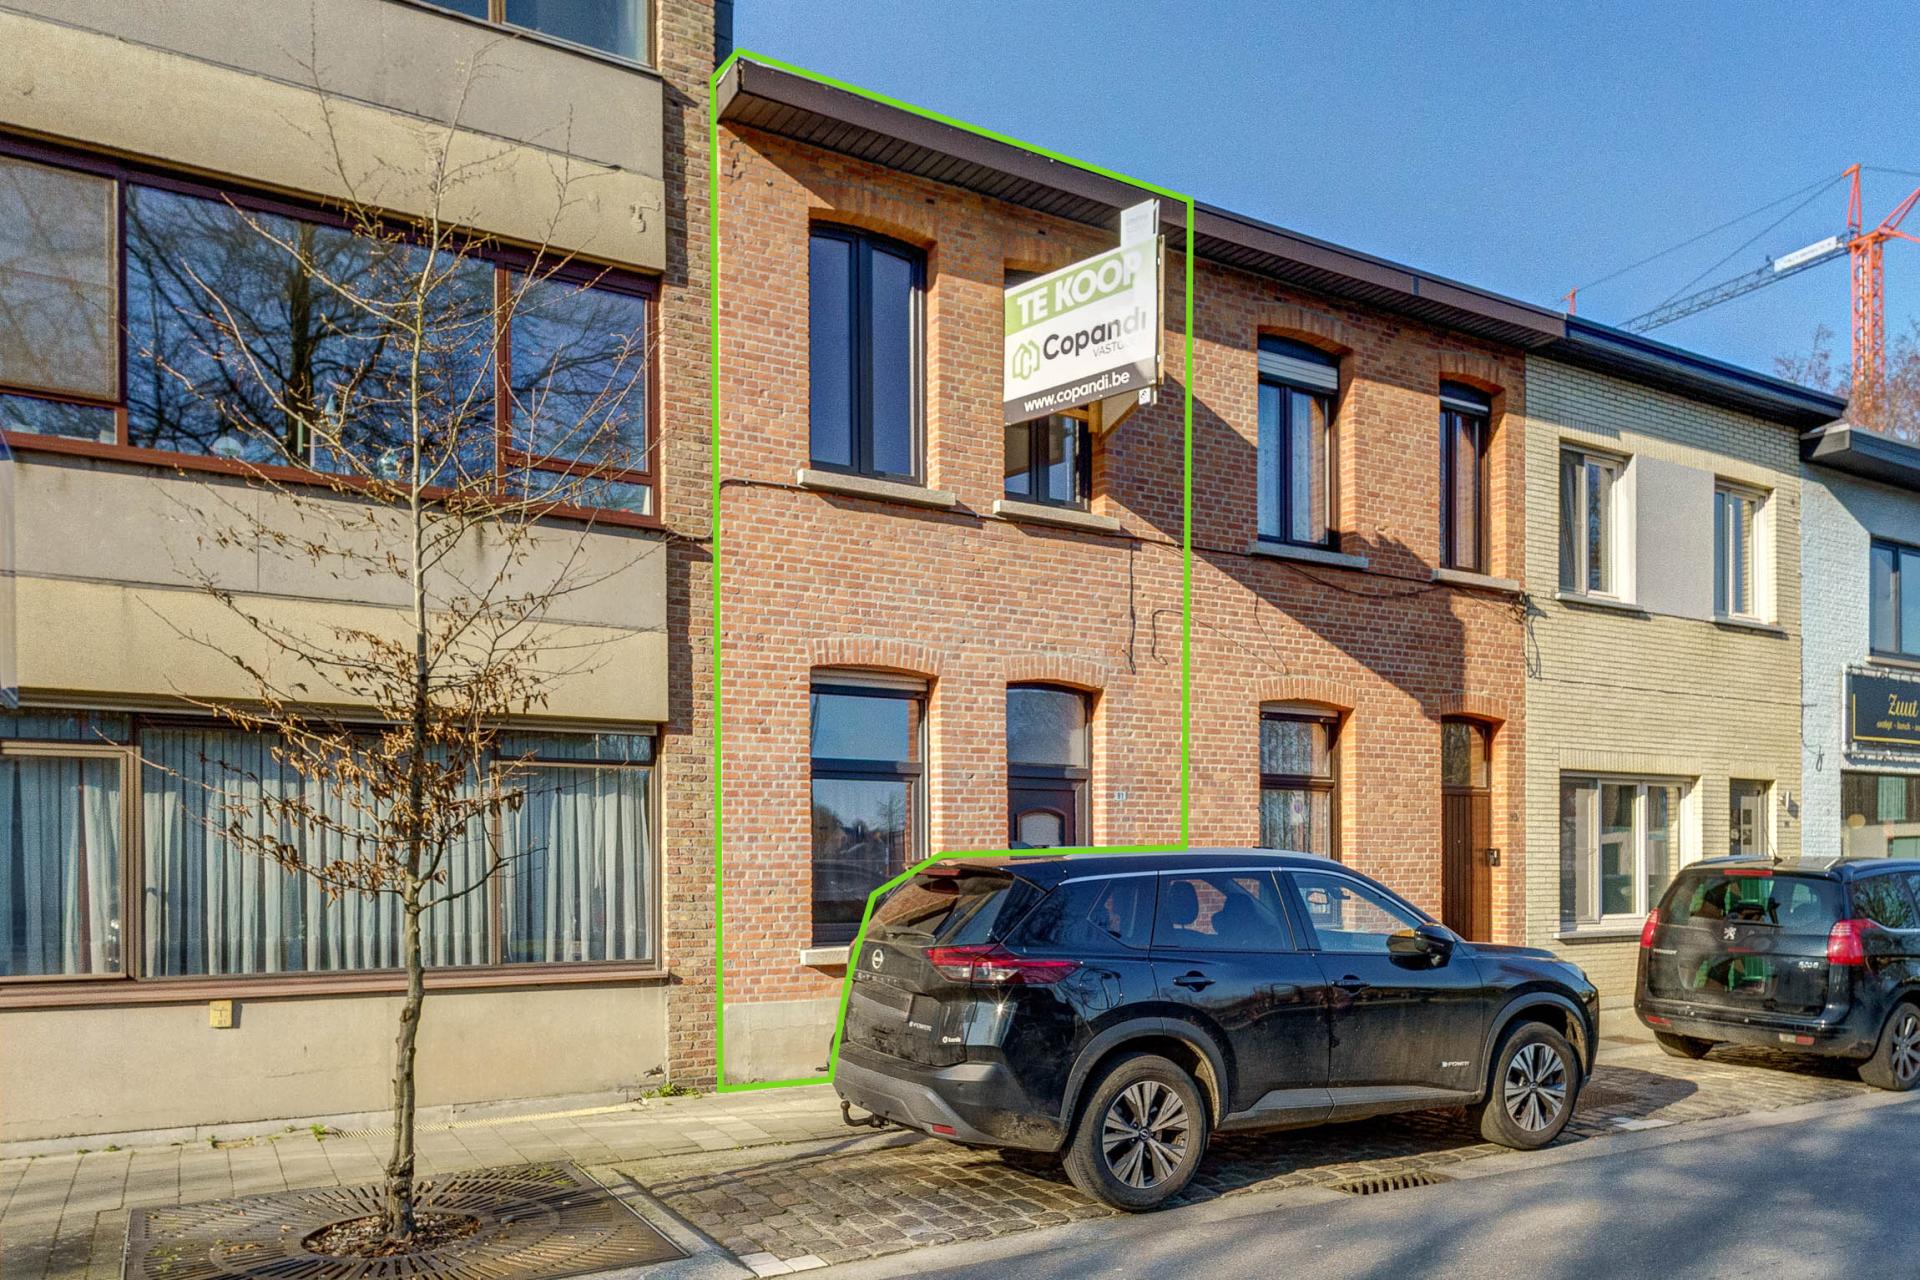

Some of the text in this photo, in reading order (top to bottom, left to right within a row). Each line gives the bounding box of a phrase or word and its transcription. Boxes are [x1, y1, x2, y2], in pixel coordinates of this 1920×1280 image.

[1017, 251, 1142, 326] TE KOOP
[1043, 306, 1147, 360] Copandi
[1024, 371, 1130, 412] www.copandi.be
